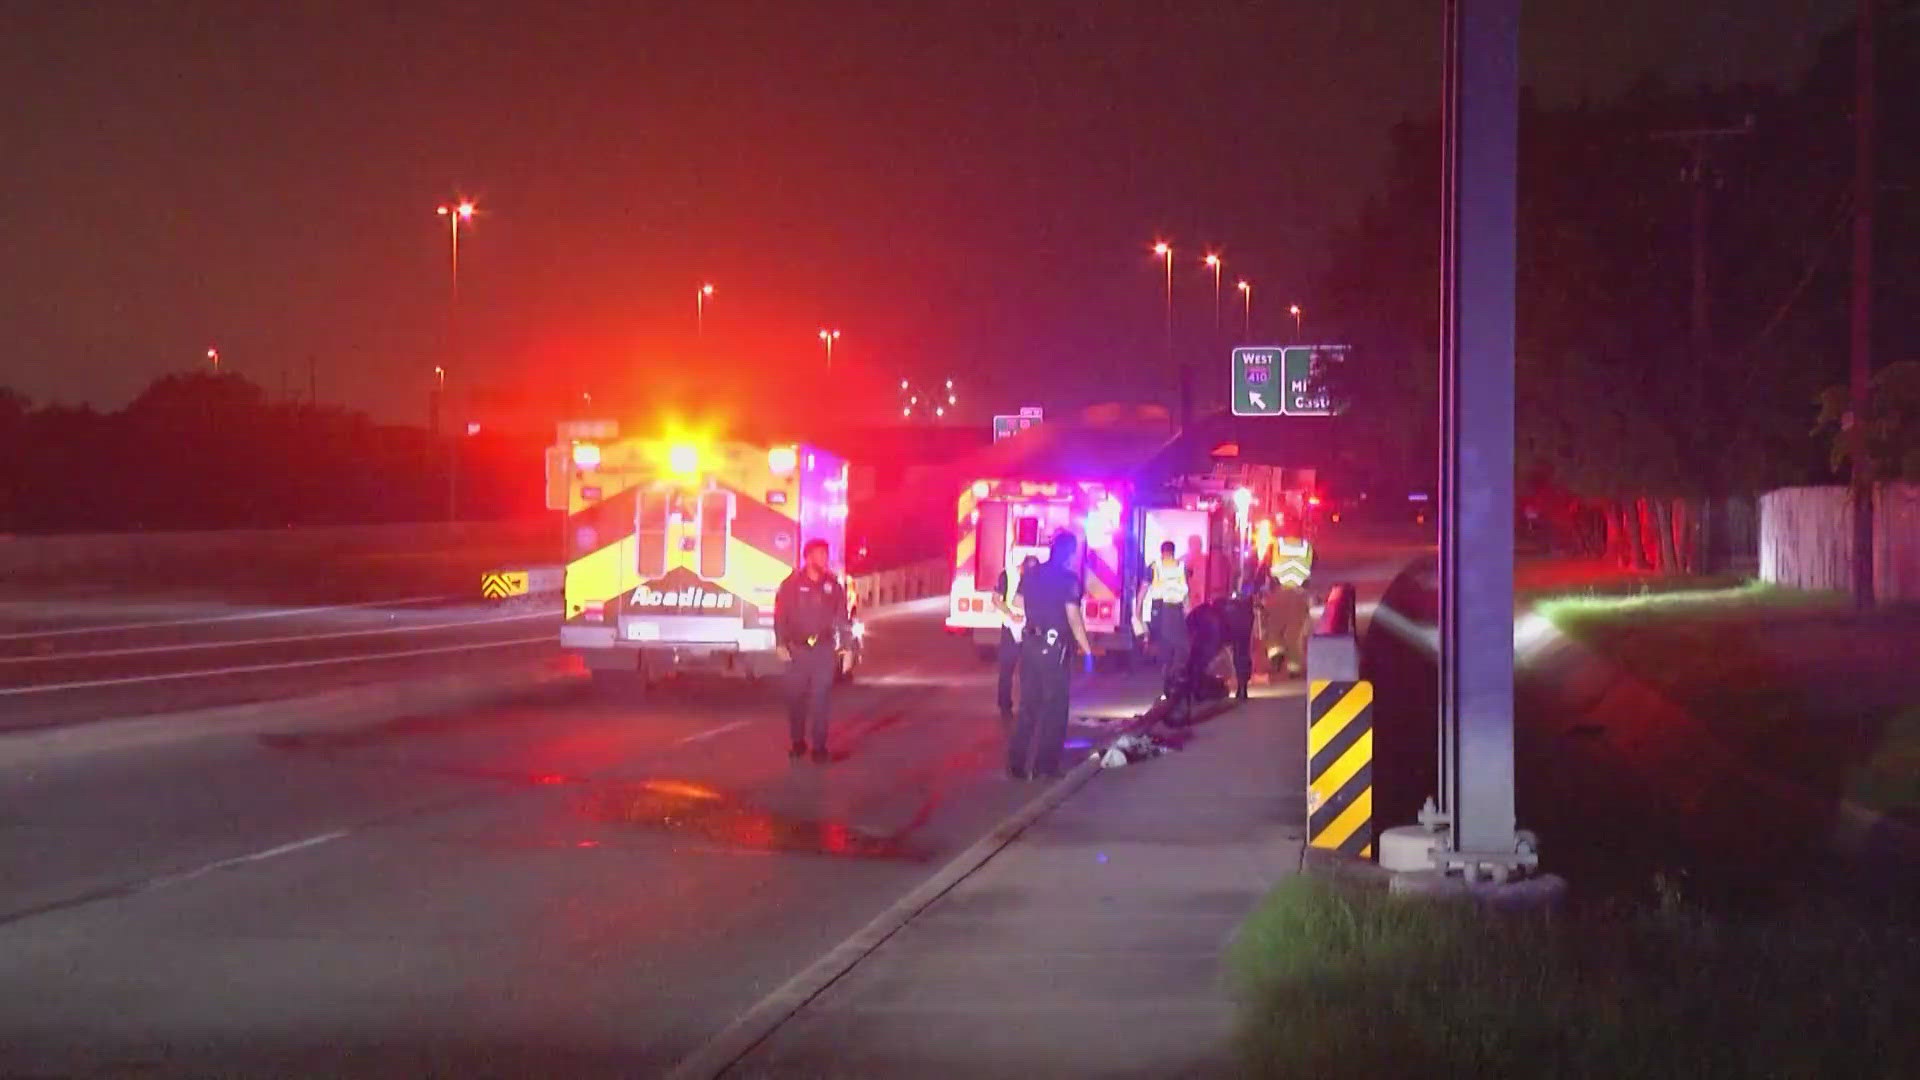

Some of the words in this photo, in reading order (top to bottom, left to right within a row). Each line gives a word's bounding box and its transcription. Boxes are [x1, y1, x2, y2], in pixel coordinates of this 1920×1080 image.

[1242, 352, 1273, 365] WEST
[1248, 372, 1268, 383] 410
[630, 585, 733, 608] Acadian
